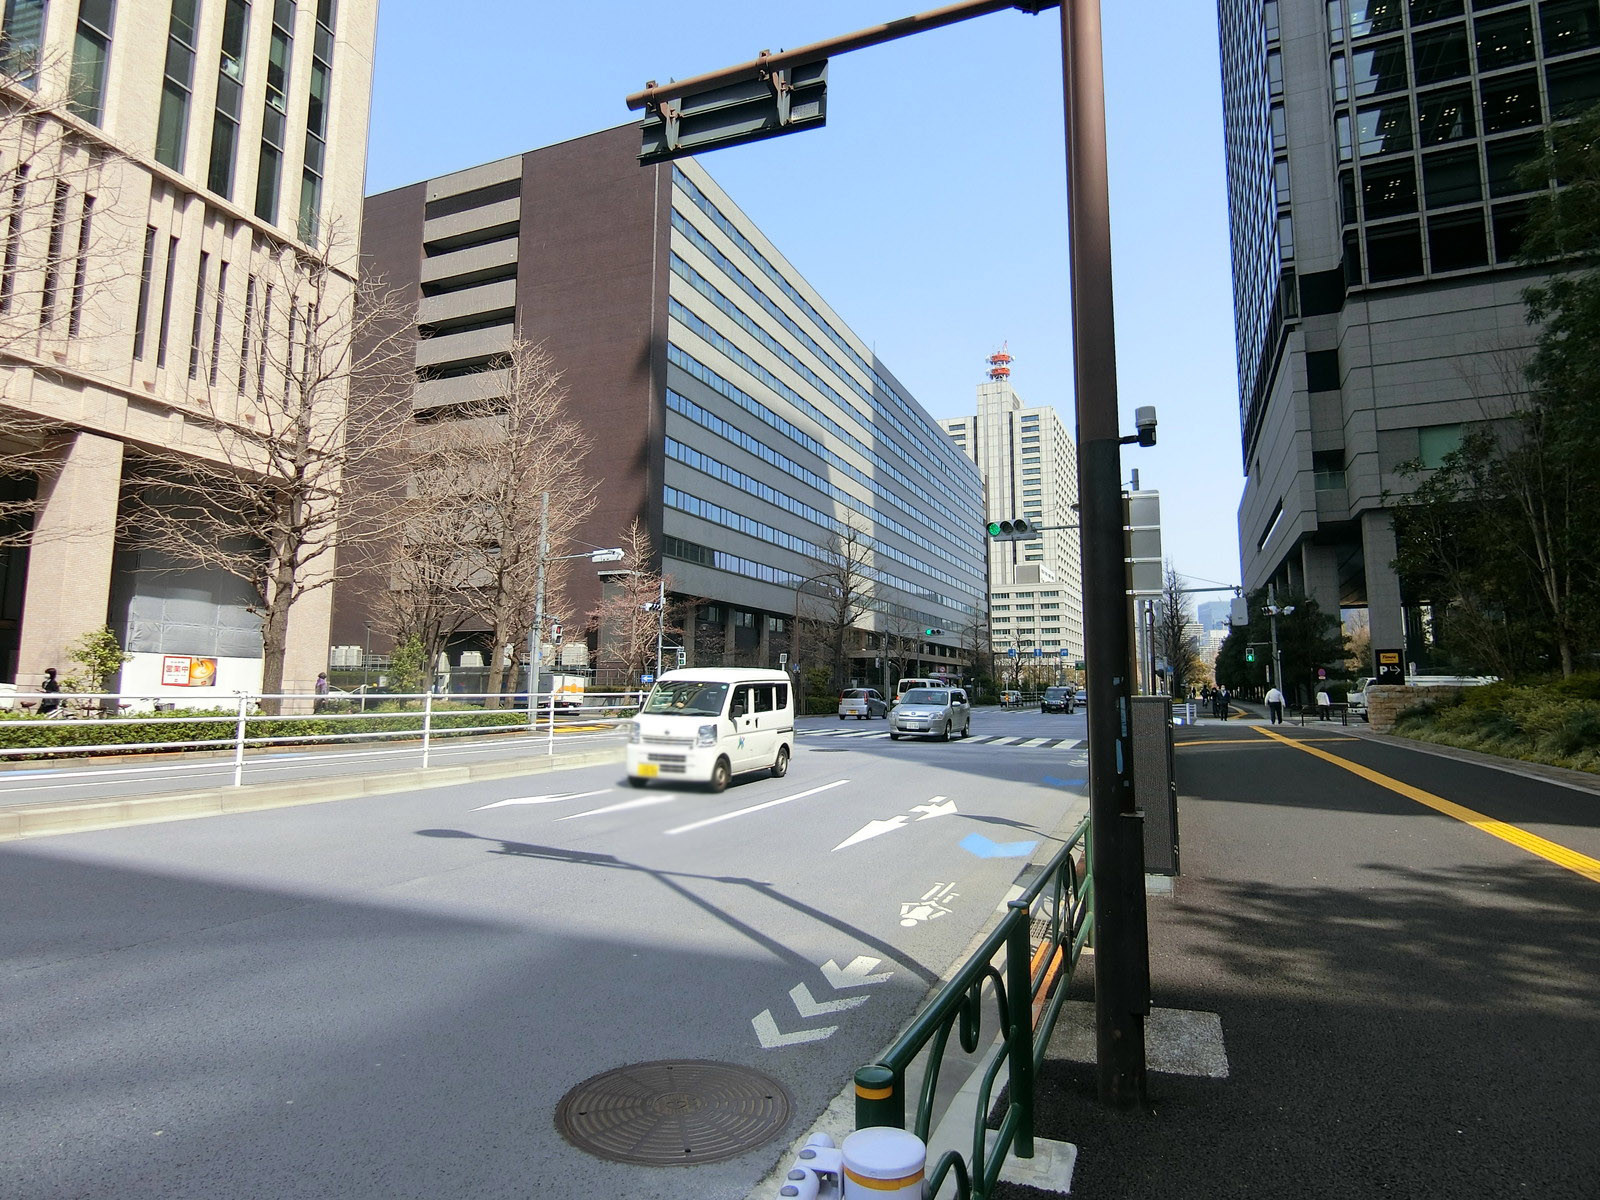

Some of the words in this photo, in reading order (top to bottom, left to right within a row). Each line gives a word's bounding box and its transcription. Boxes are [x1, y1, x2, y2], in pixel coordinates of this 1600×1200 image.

[166, 665, 188, 673] 営業中
[1380, 666, 1388, 675] P
